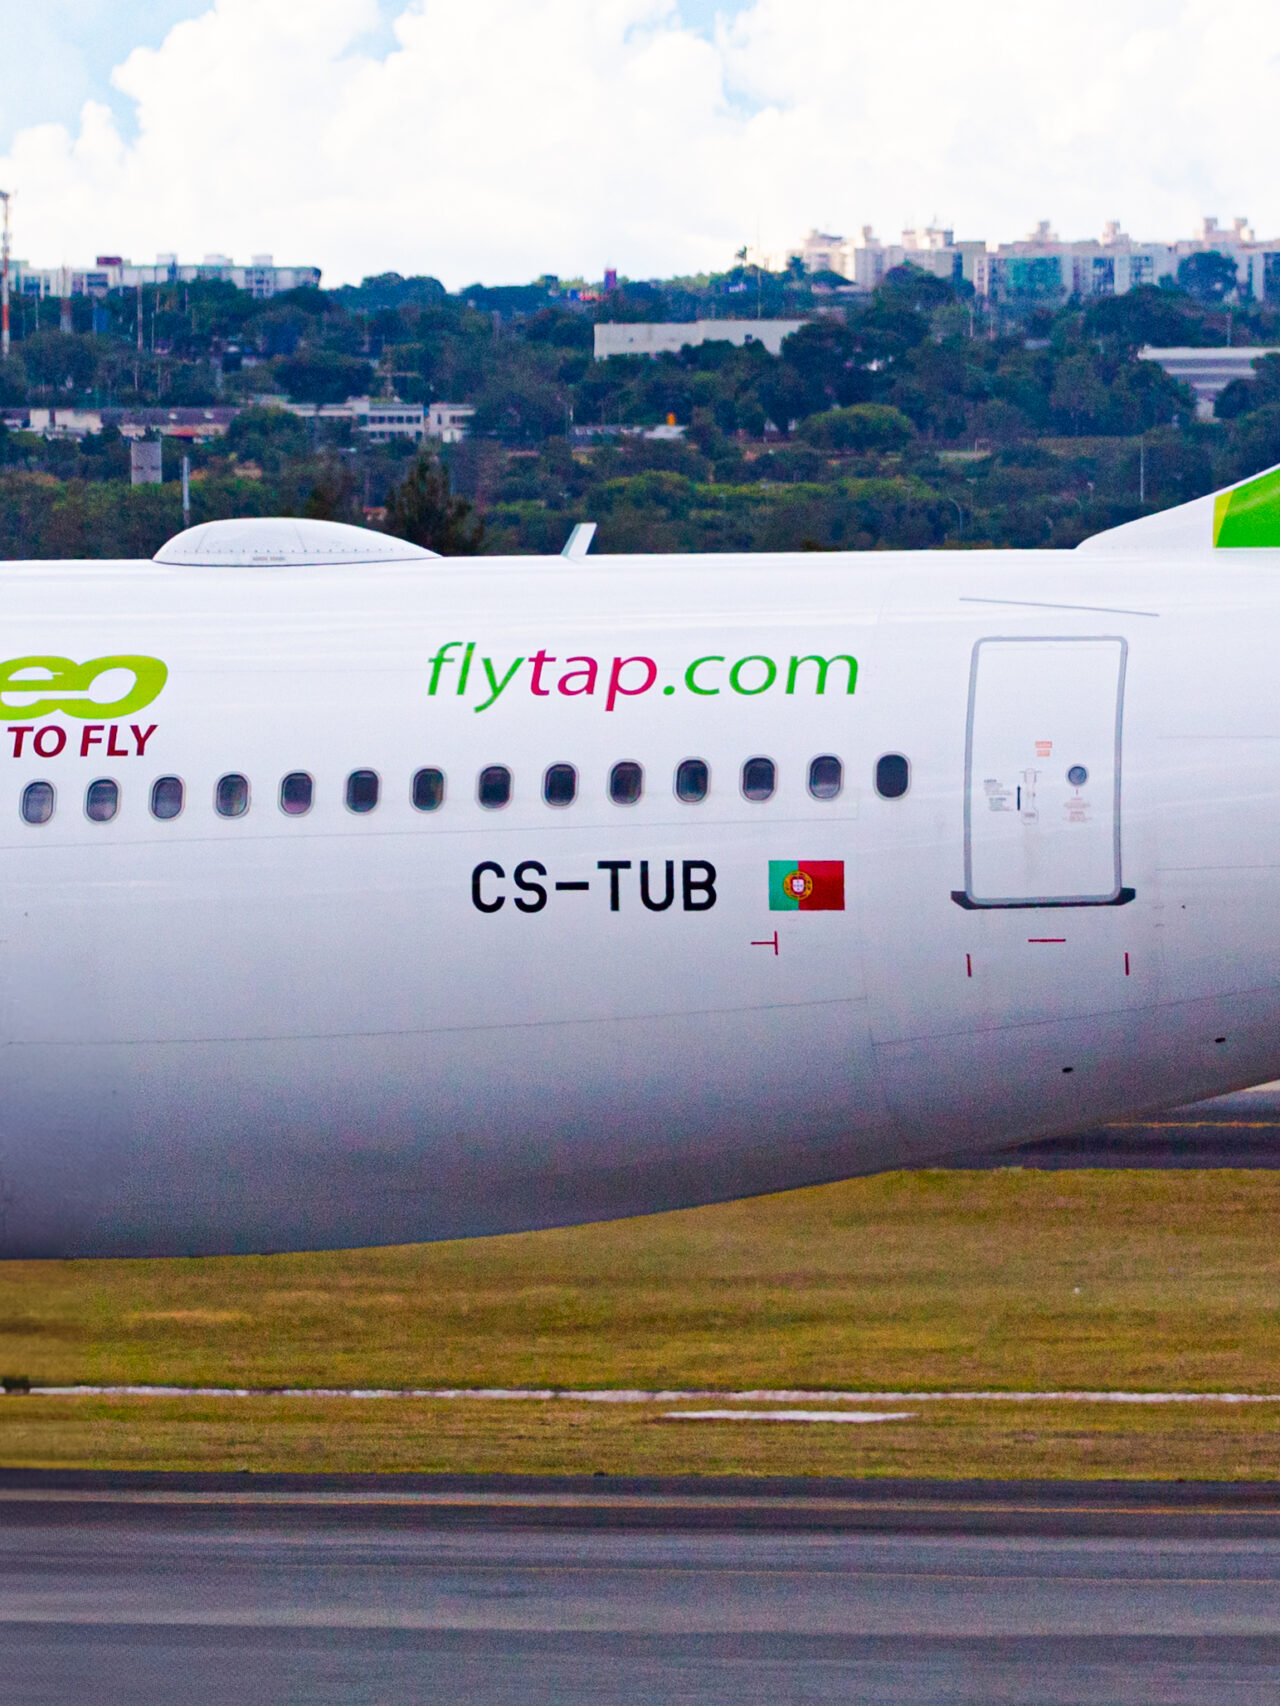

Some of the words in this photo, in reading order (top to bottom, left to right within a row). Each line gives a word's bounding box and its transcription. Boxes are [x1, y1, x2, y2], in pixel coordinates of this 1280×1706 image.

[428, 641, 859, 713] flytap.com
[6, 725, 67, 759] TO
[78, 724, 159, 758] FLY
[471, 860, 718, 914] CS-TUB
